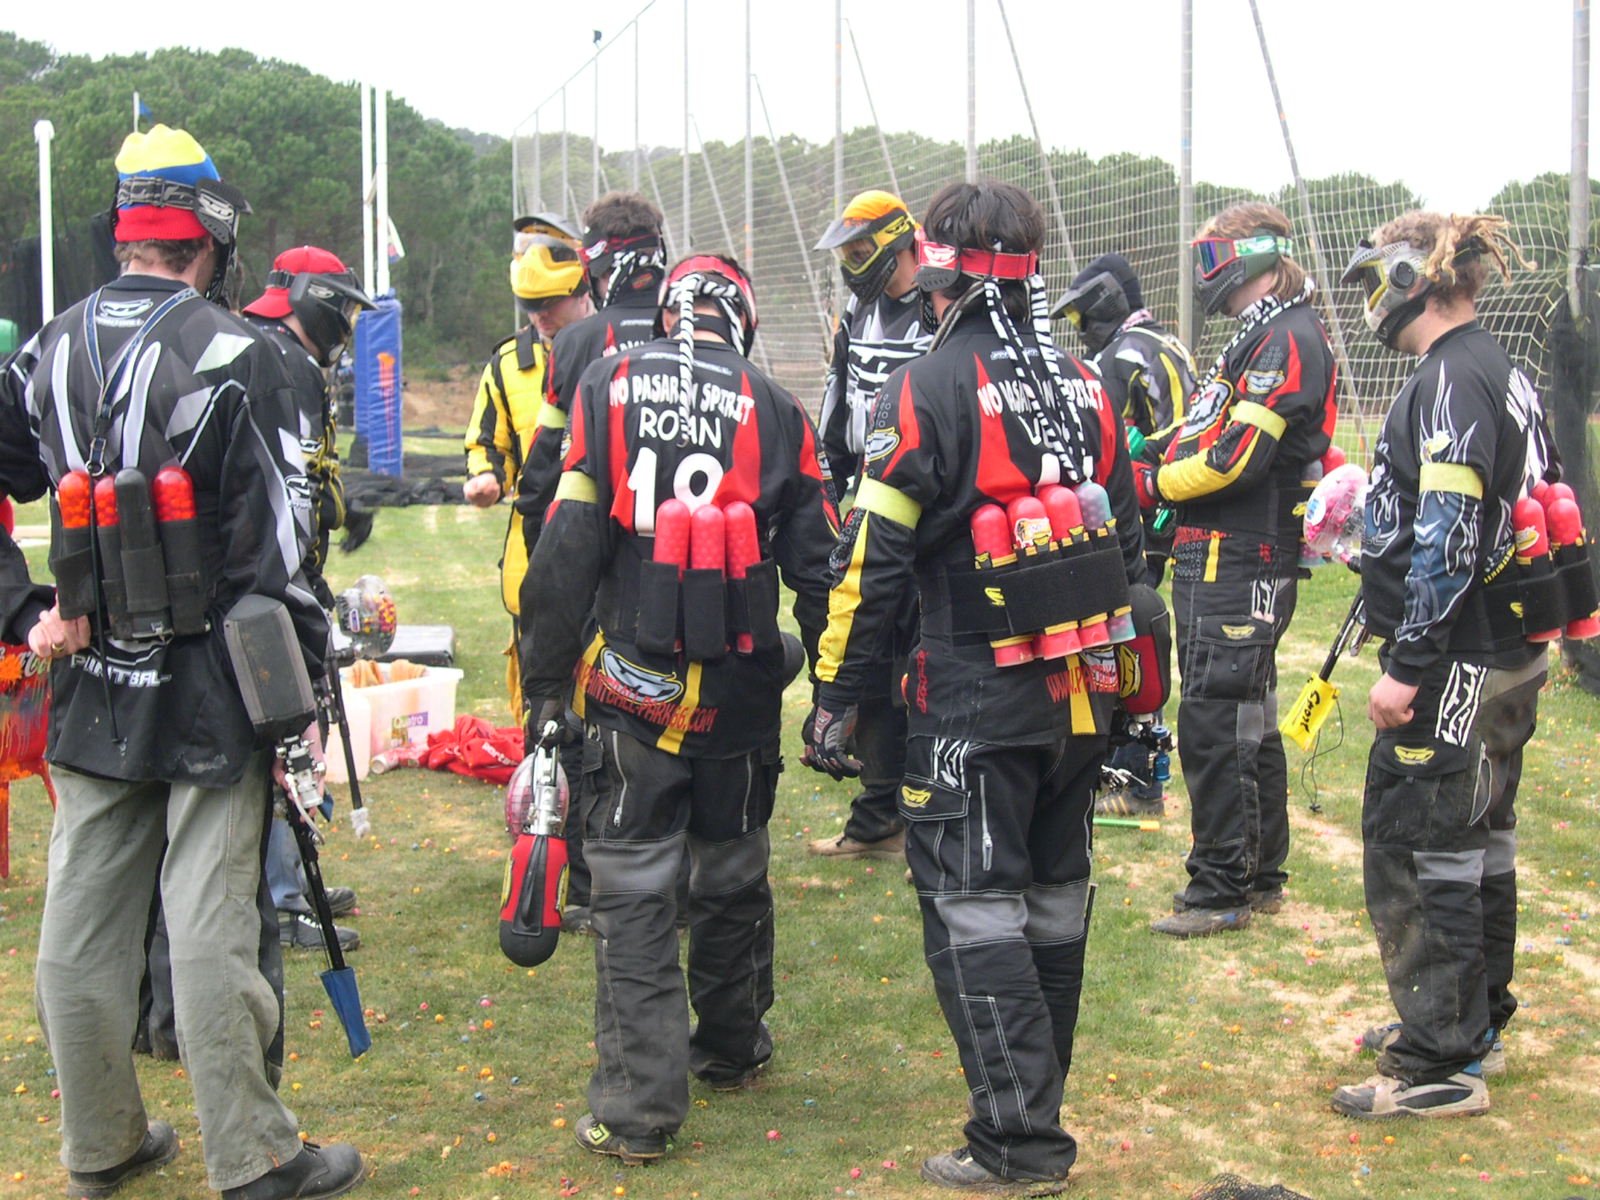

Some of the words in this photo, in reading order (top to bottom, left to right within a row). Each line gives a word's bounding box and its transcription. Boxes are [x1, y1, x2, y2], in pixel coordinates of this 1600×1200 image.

[609, 376, 629, 408] NO
[700, 382, 755, 426] SPIRIT
[977, 382, 1003, 418] NO
